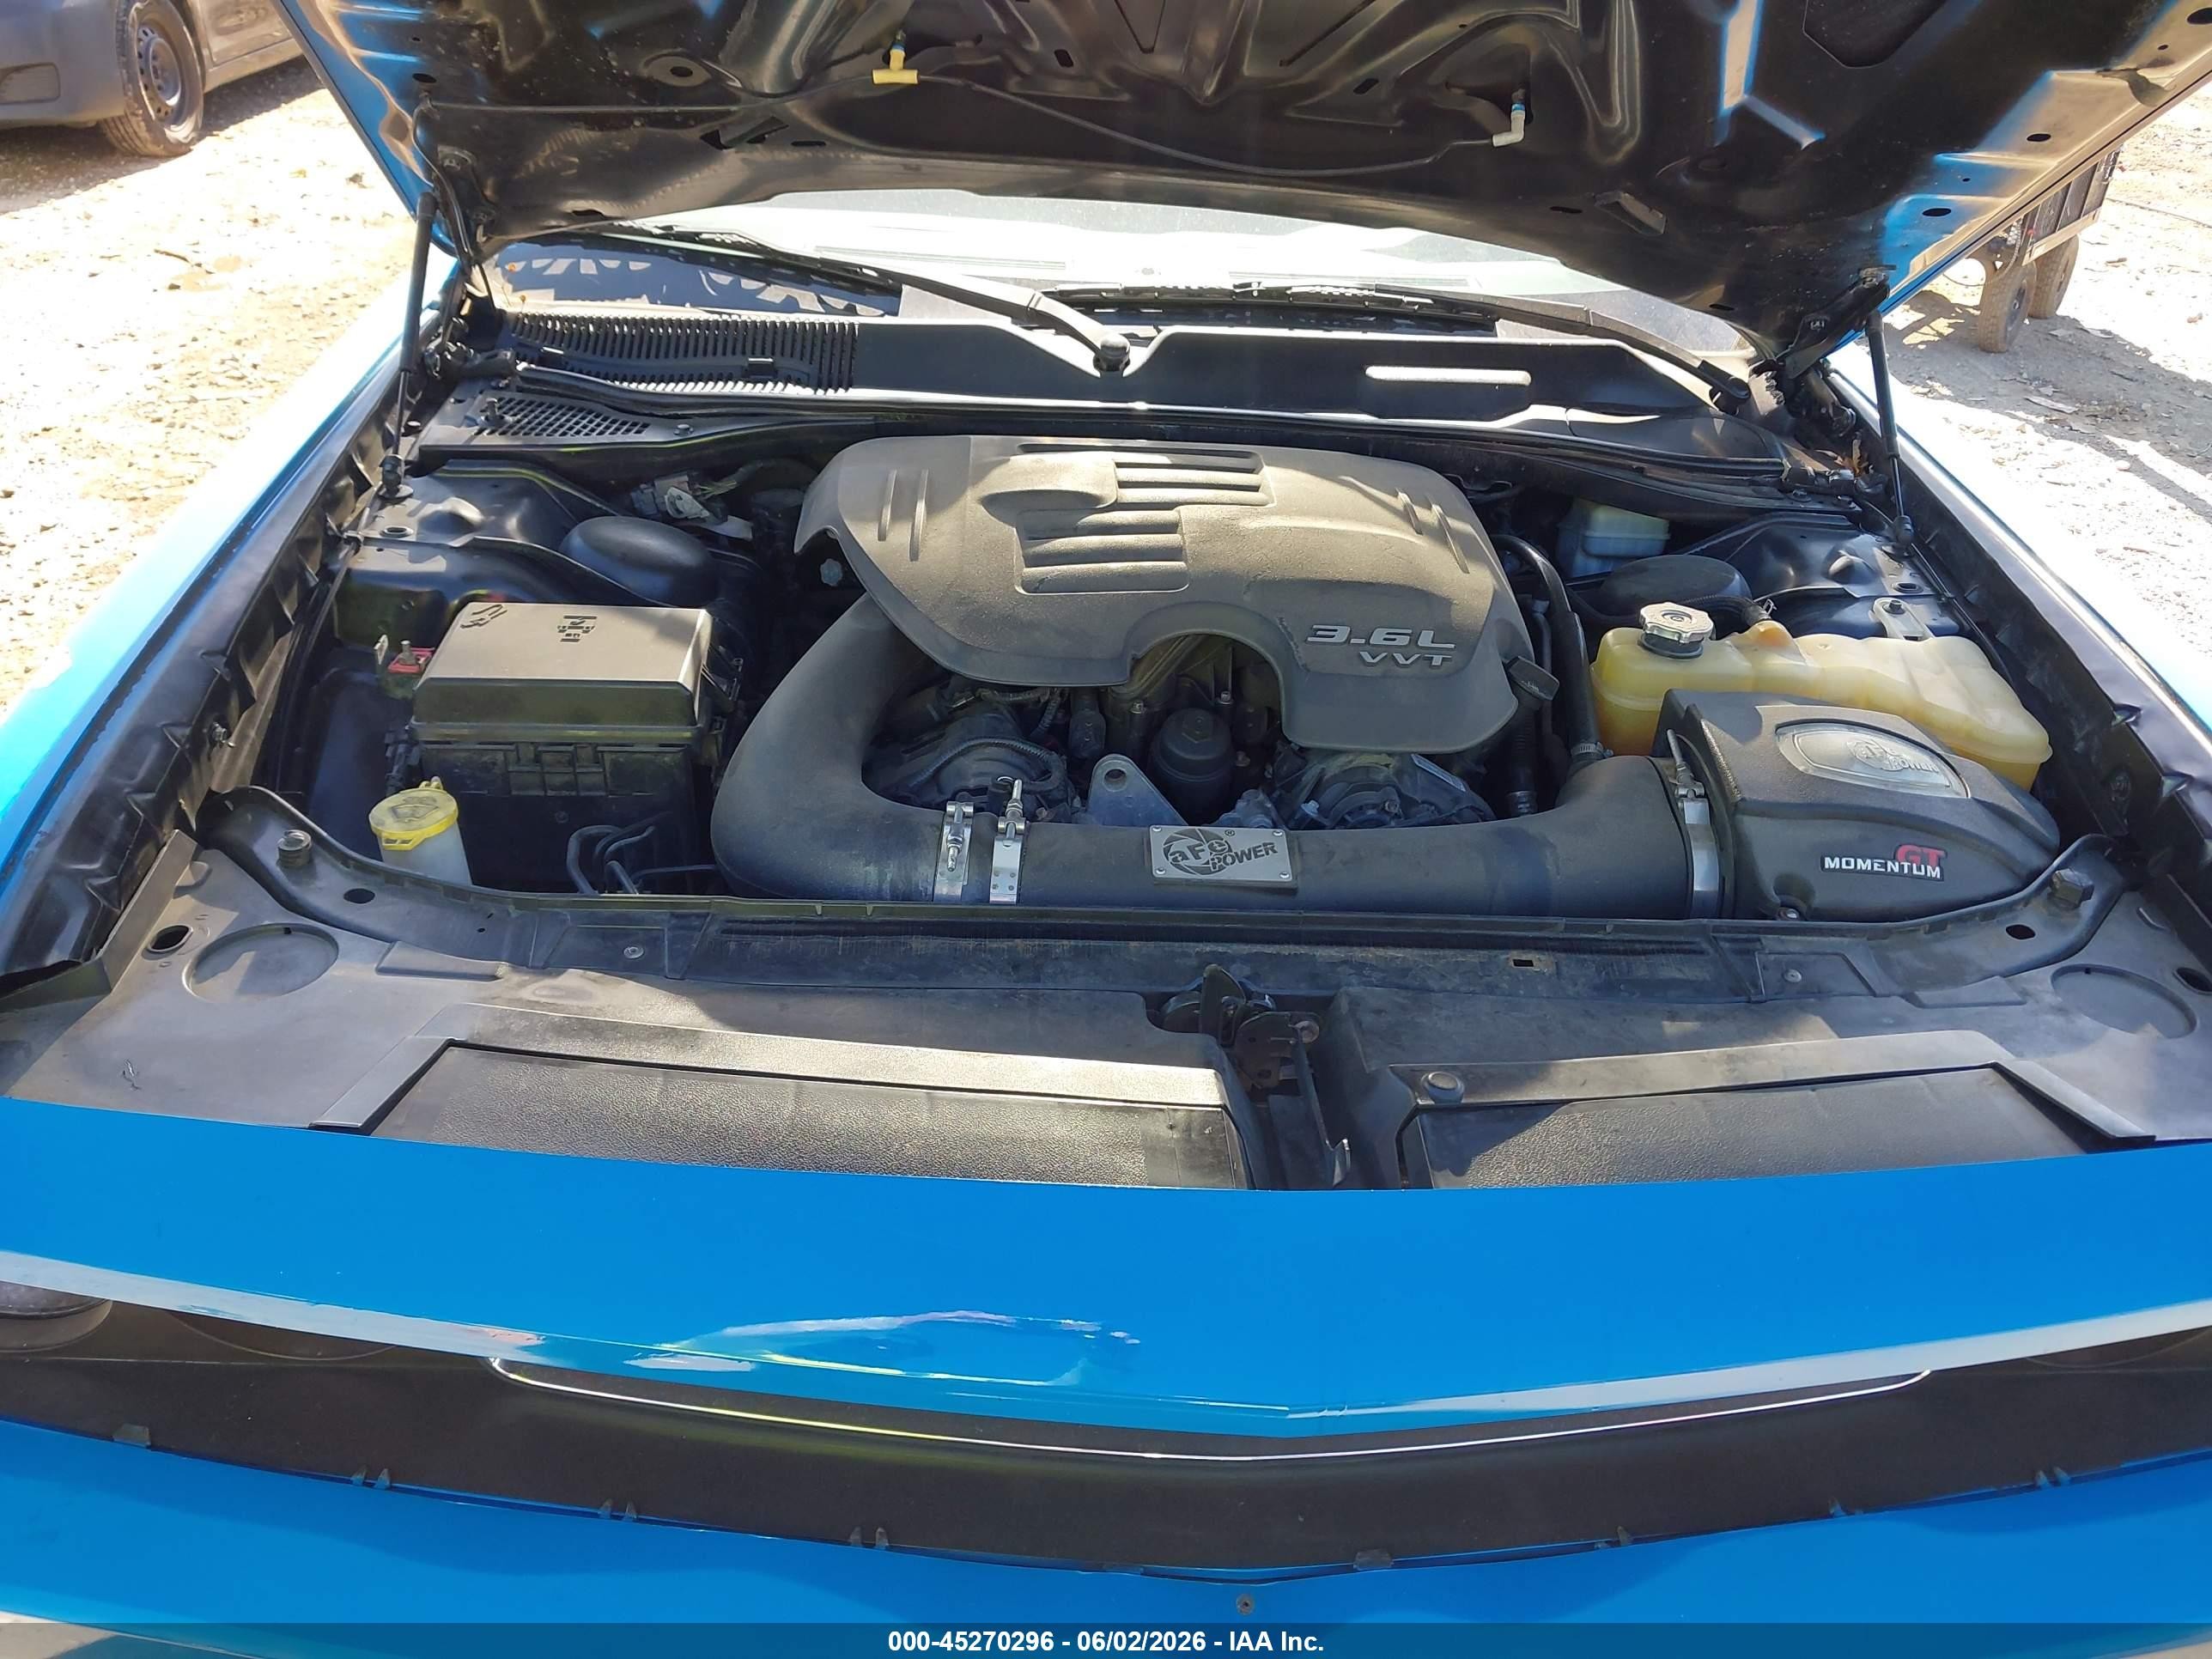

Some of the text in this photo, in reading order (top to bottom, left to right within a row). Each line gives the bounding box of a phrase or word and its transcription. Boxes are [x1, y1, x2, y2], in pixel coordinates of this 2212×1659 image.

[1307, 624, 1456, 649] 3.6L
[1359, 651, 1453, 666] VVT
[1211, 843, 1278, 870] POWER
[1897, 844, 1946, 866] GT
[1825, 856, 1941, 878] MOMENTUM
